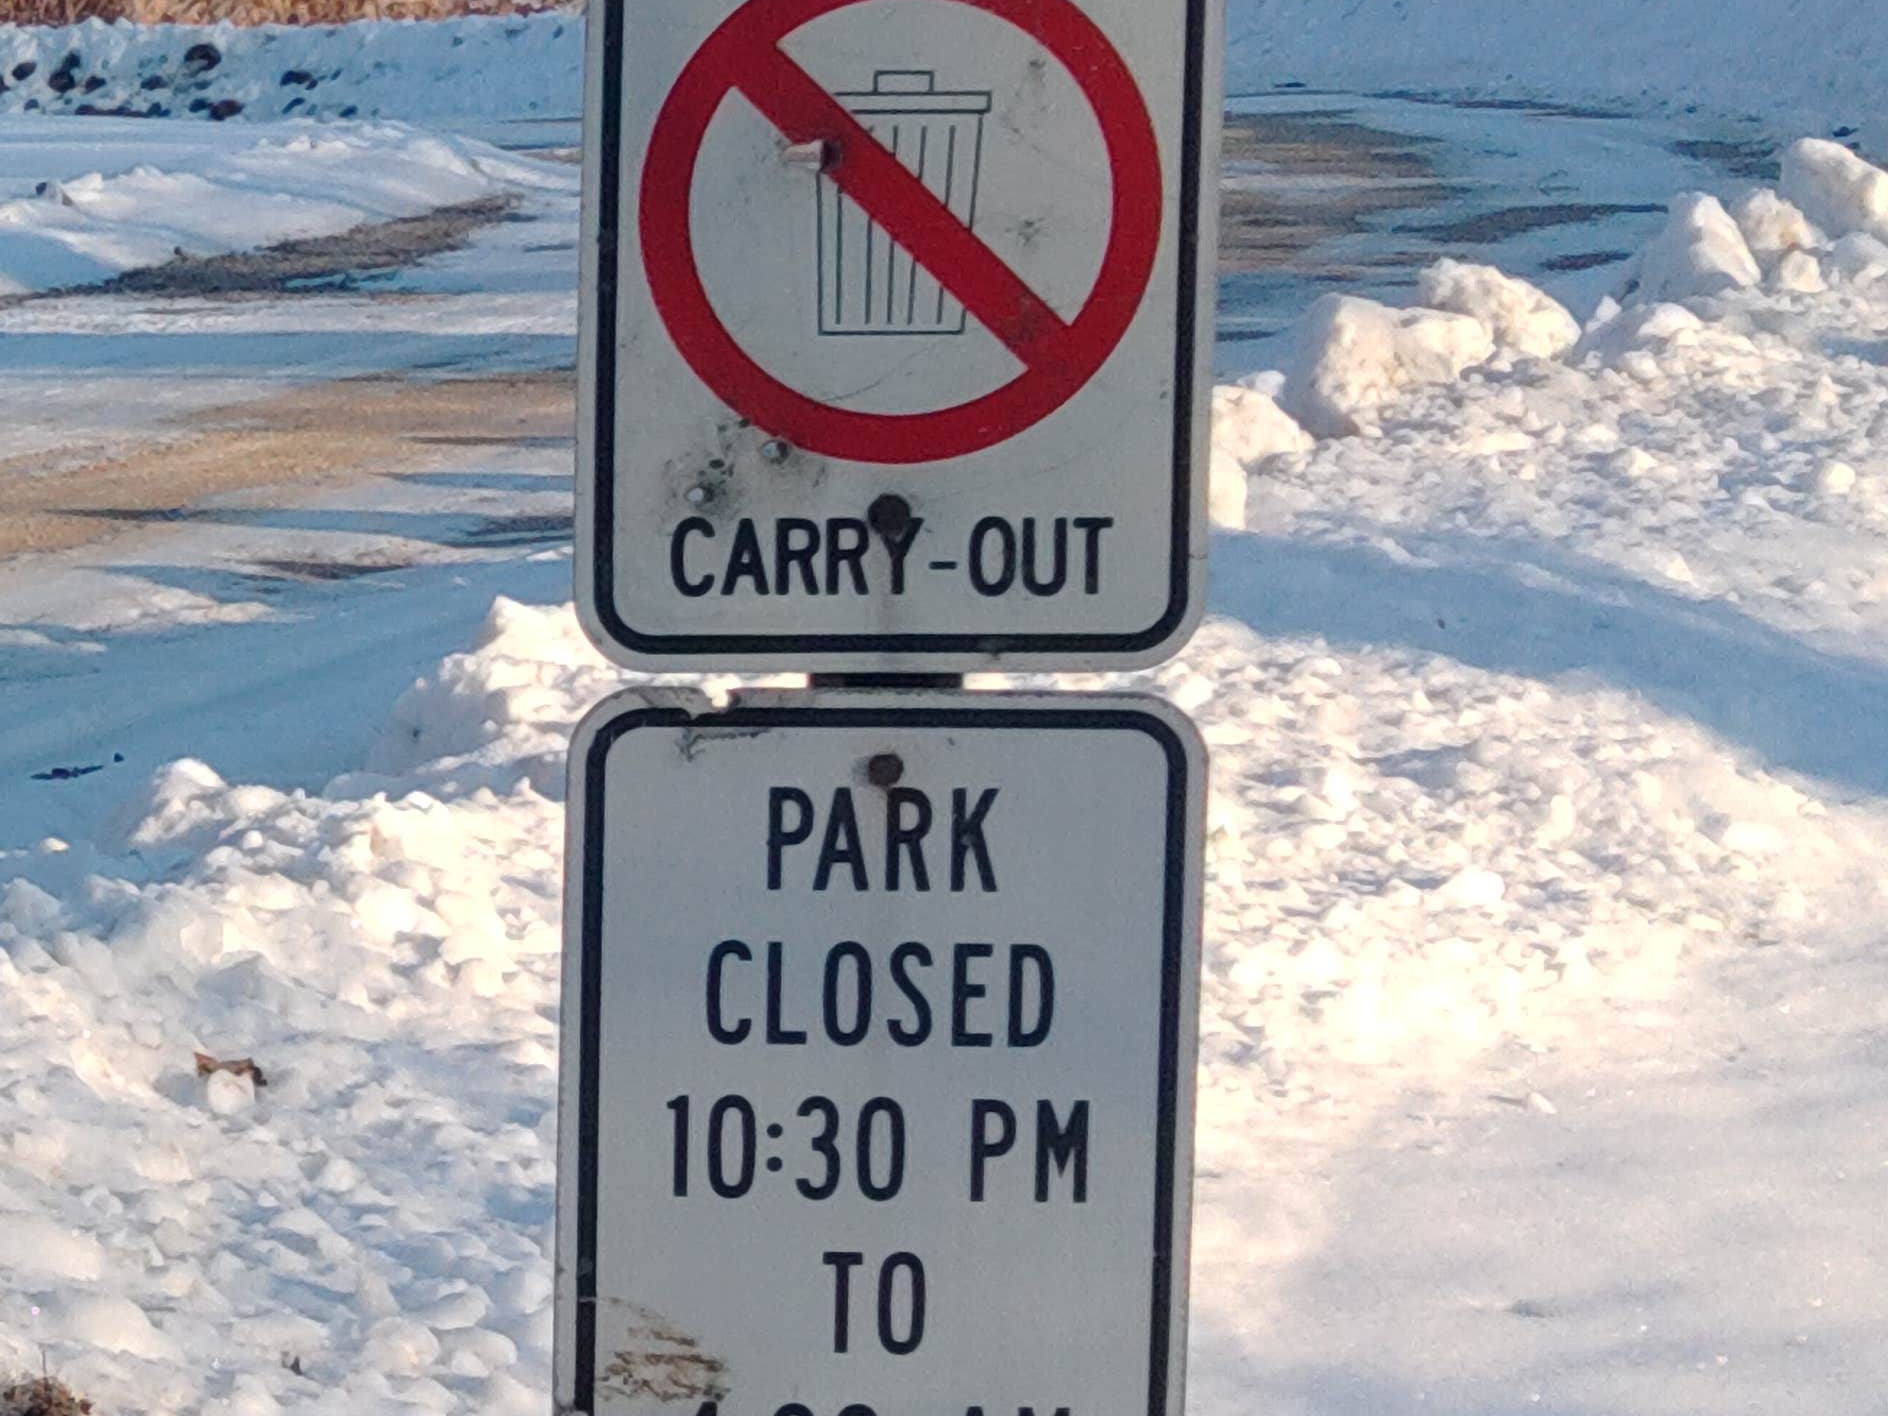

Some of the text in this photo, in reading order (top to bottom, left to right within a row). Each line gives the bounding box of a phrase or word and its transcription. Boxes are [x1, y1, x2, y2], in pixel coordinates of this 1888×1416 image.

[671, 516, 1113, 597] CARRY-OUT
[767, 786, 999, 892] PARK
[707, 940, 1054, 1047] CLOSED
[667, 1095, 1088, 1203] 10:30 PM
[823, 1252, 925, 1355] TO
